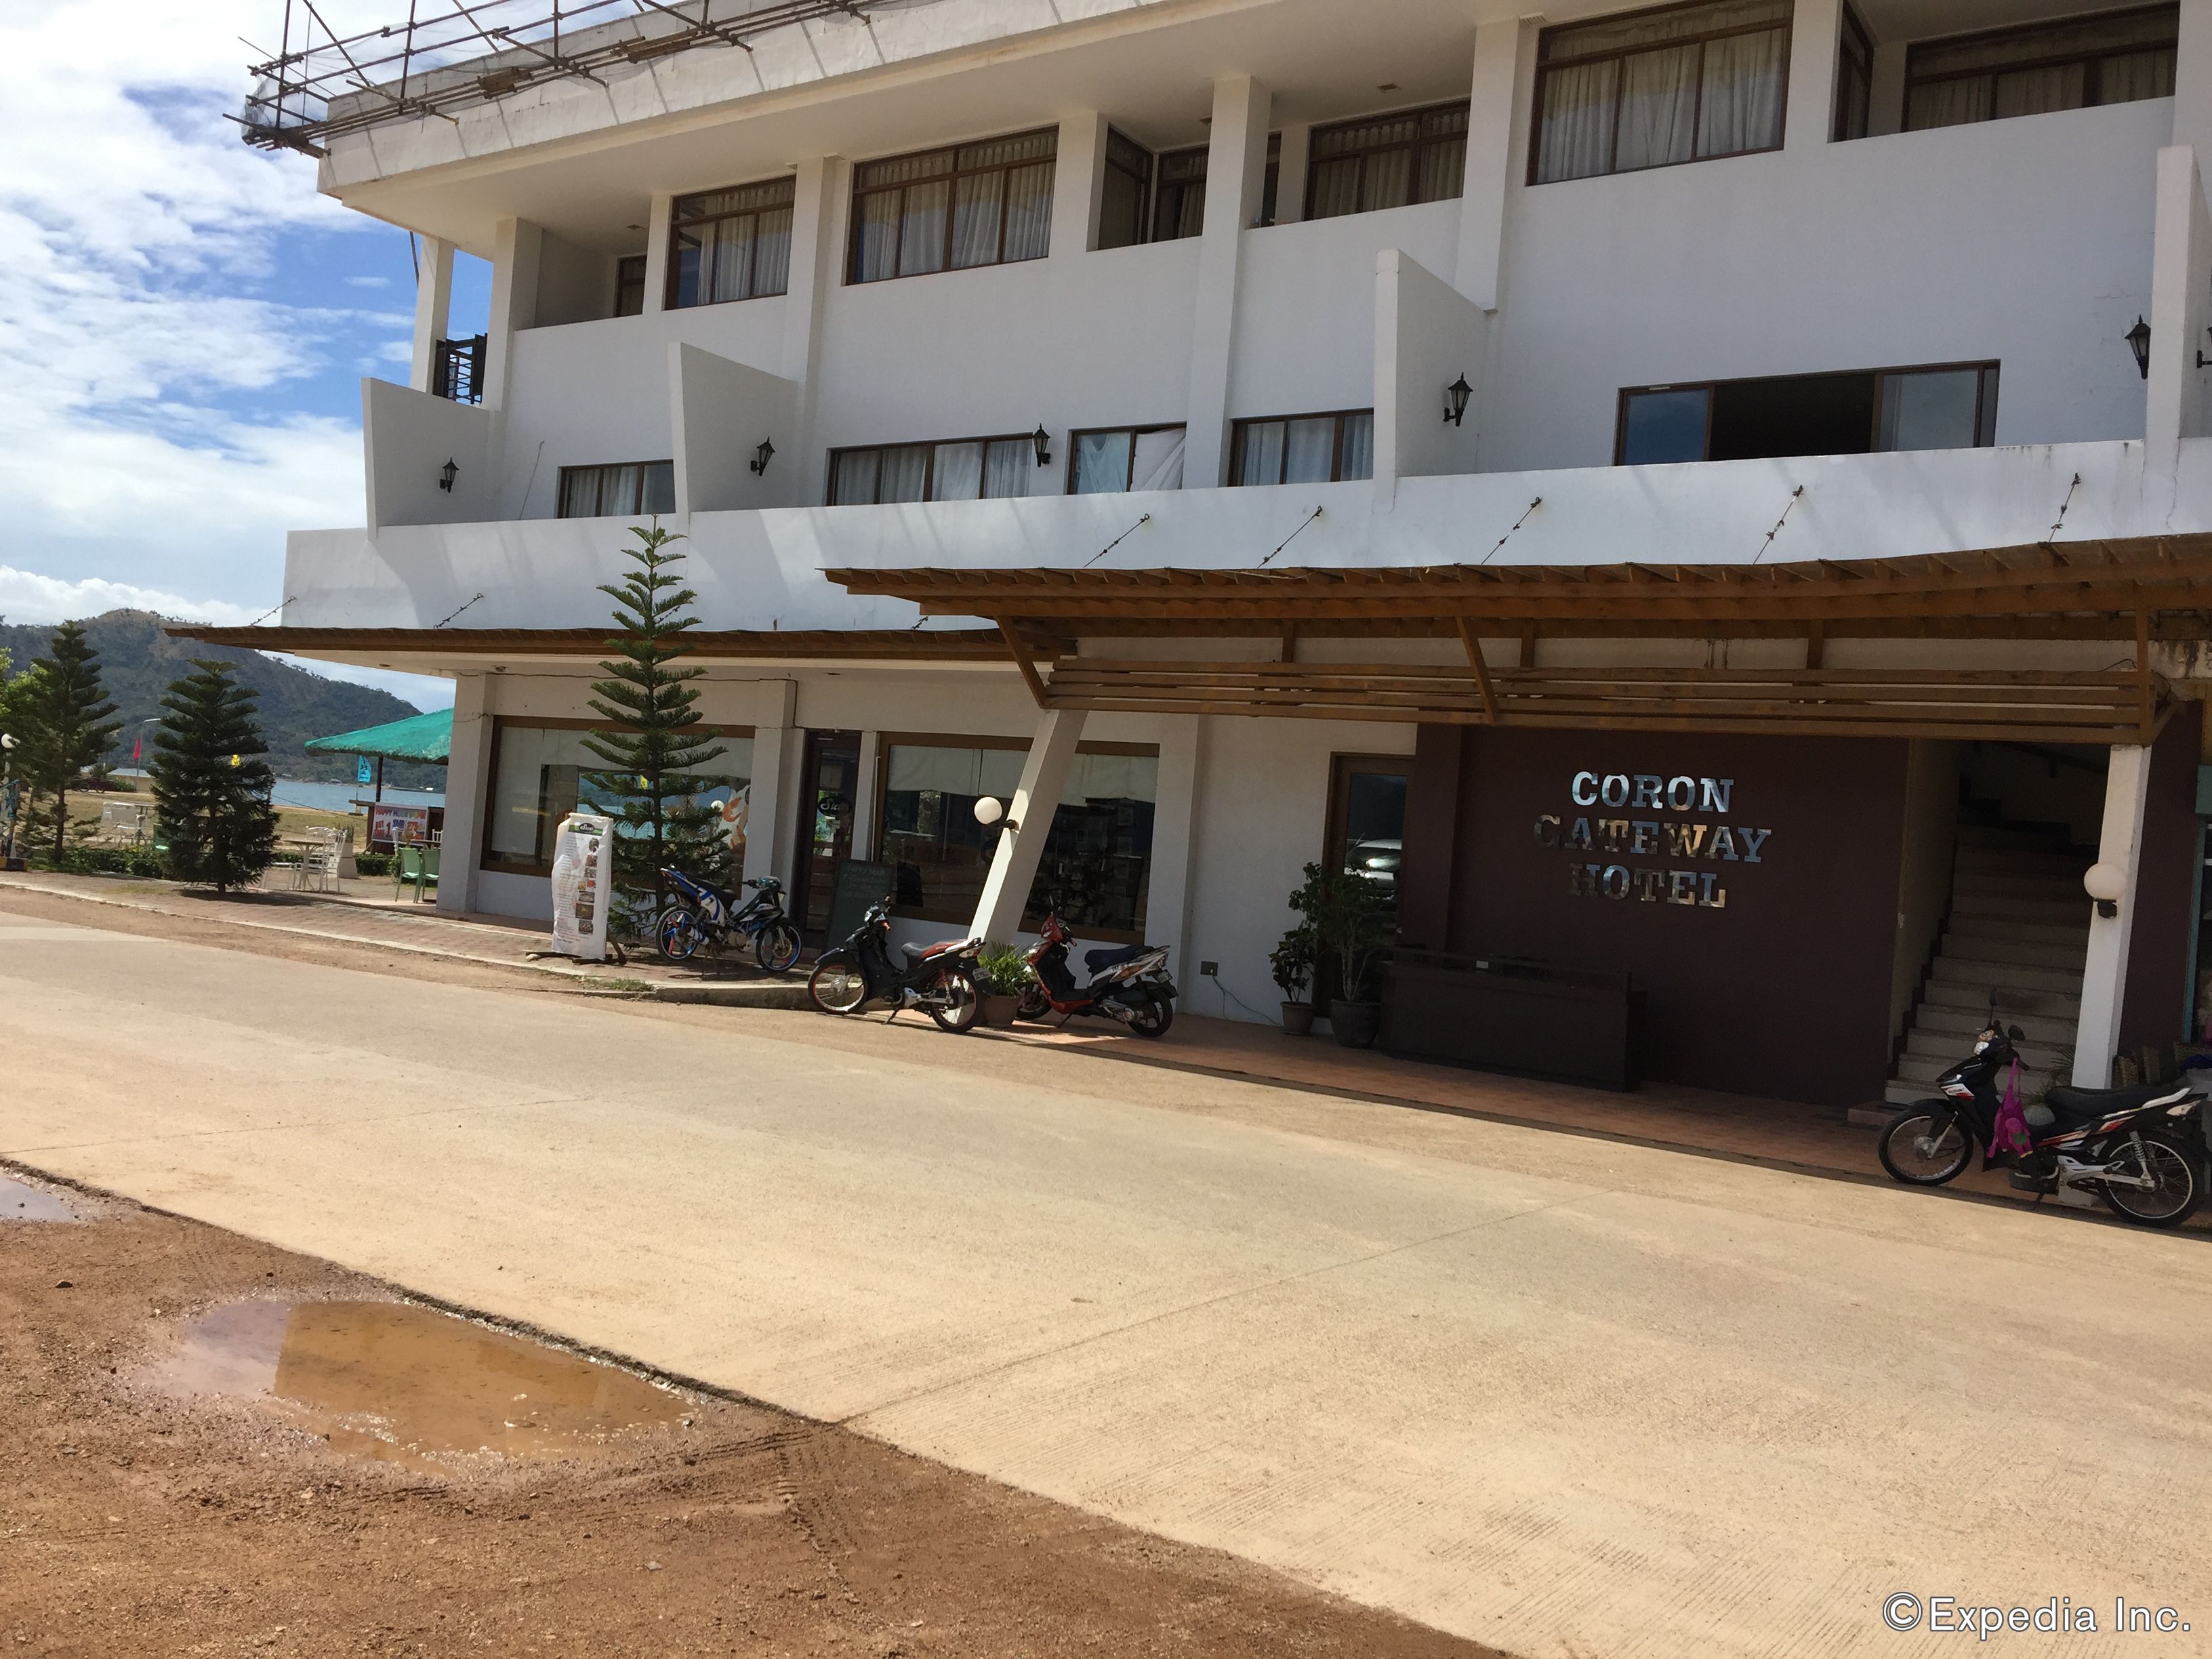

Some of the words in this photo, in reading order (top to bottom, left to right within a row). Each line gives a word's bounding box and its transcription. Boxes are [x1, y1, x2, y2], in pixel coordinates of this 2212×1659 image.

[1572, 771, 1734, 813] CORON
[1534, 815, 1771, 863] GATEWAY
[1568, 863, 1726, 908] HOTEL
